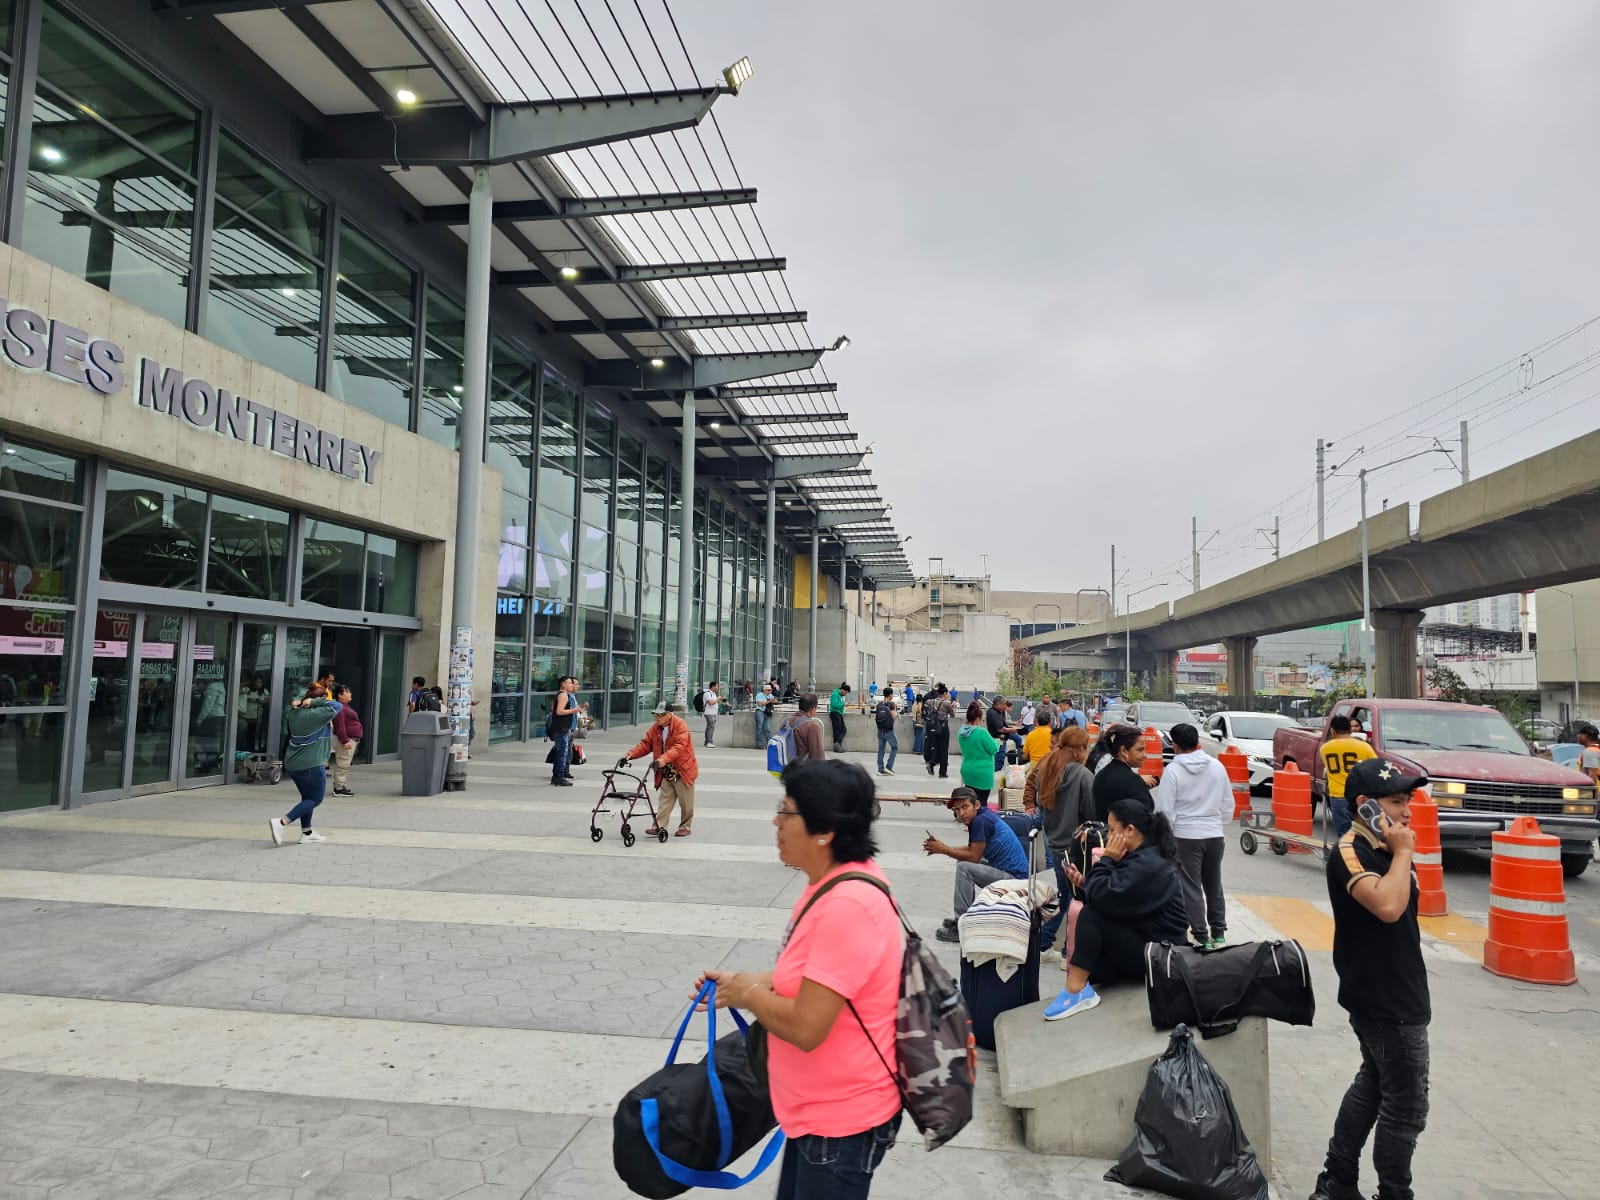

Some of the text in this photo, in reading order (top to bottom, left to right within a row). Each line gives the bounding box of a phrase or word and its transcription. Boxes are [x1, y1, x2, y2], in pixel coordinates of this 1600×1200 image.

[0, 298, 383, 485] SES MONTERREY
[1325, 751, 1358, 774] 06
